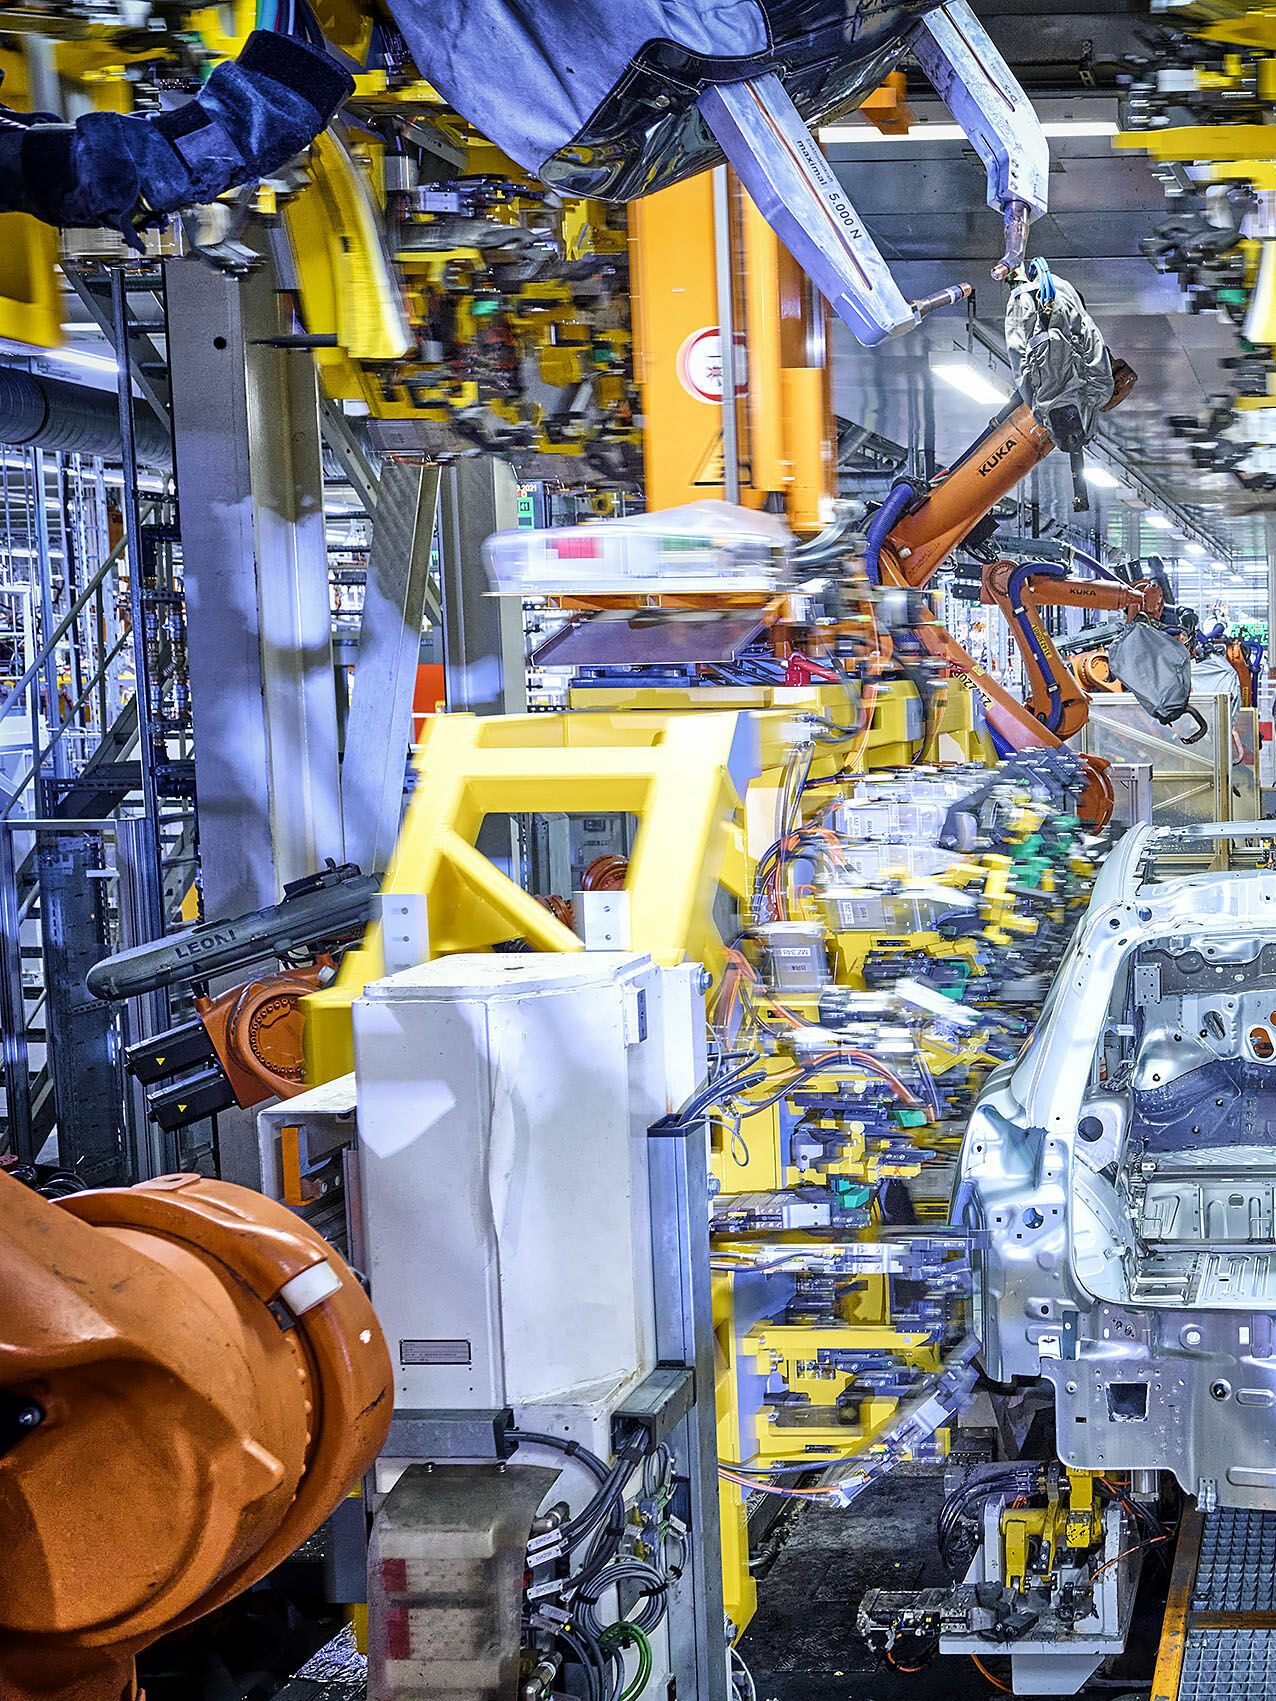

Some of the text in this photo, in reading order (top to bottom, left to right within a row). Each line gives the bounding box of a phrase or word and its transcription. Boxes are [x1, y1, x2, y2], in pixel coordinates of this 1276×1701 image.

[796, 140, 862, 239] maximal 5.000 N
[978, 439, 1017, 477] KUKA
[1069, 587, 1097, 597] KUKA
[174, 929, 237, 959] LEONI
